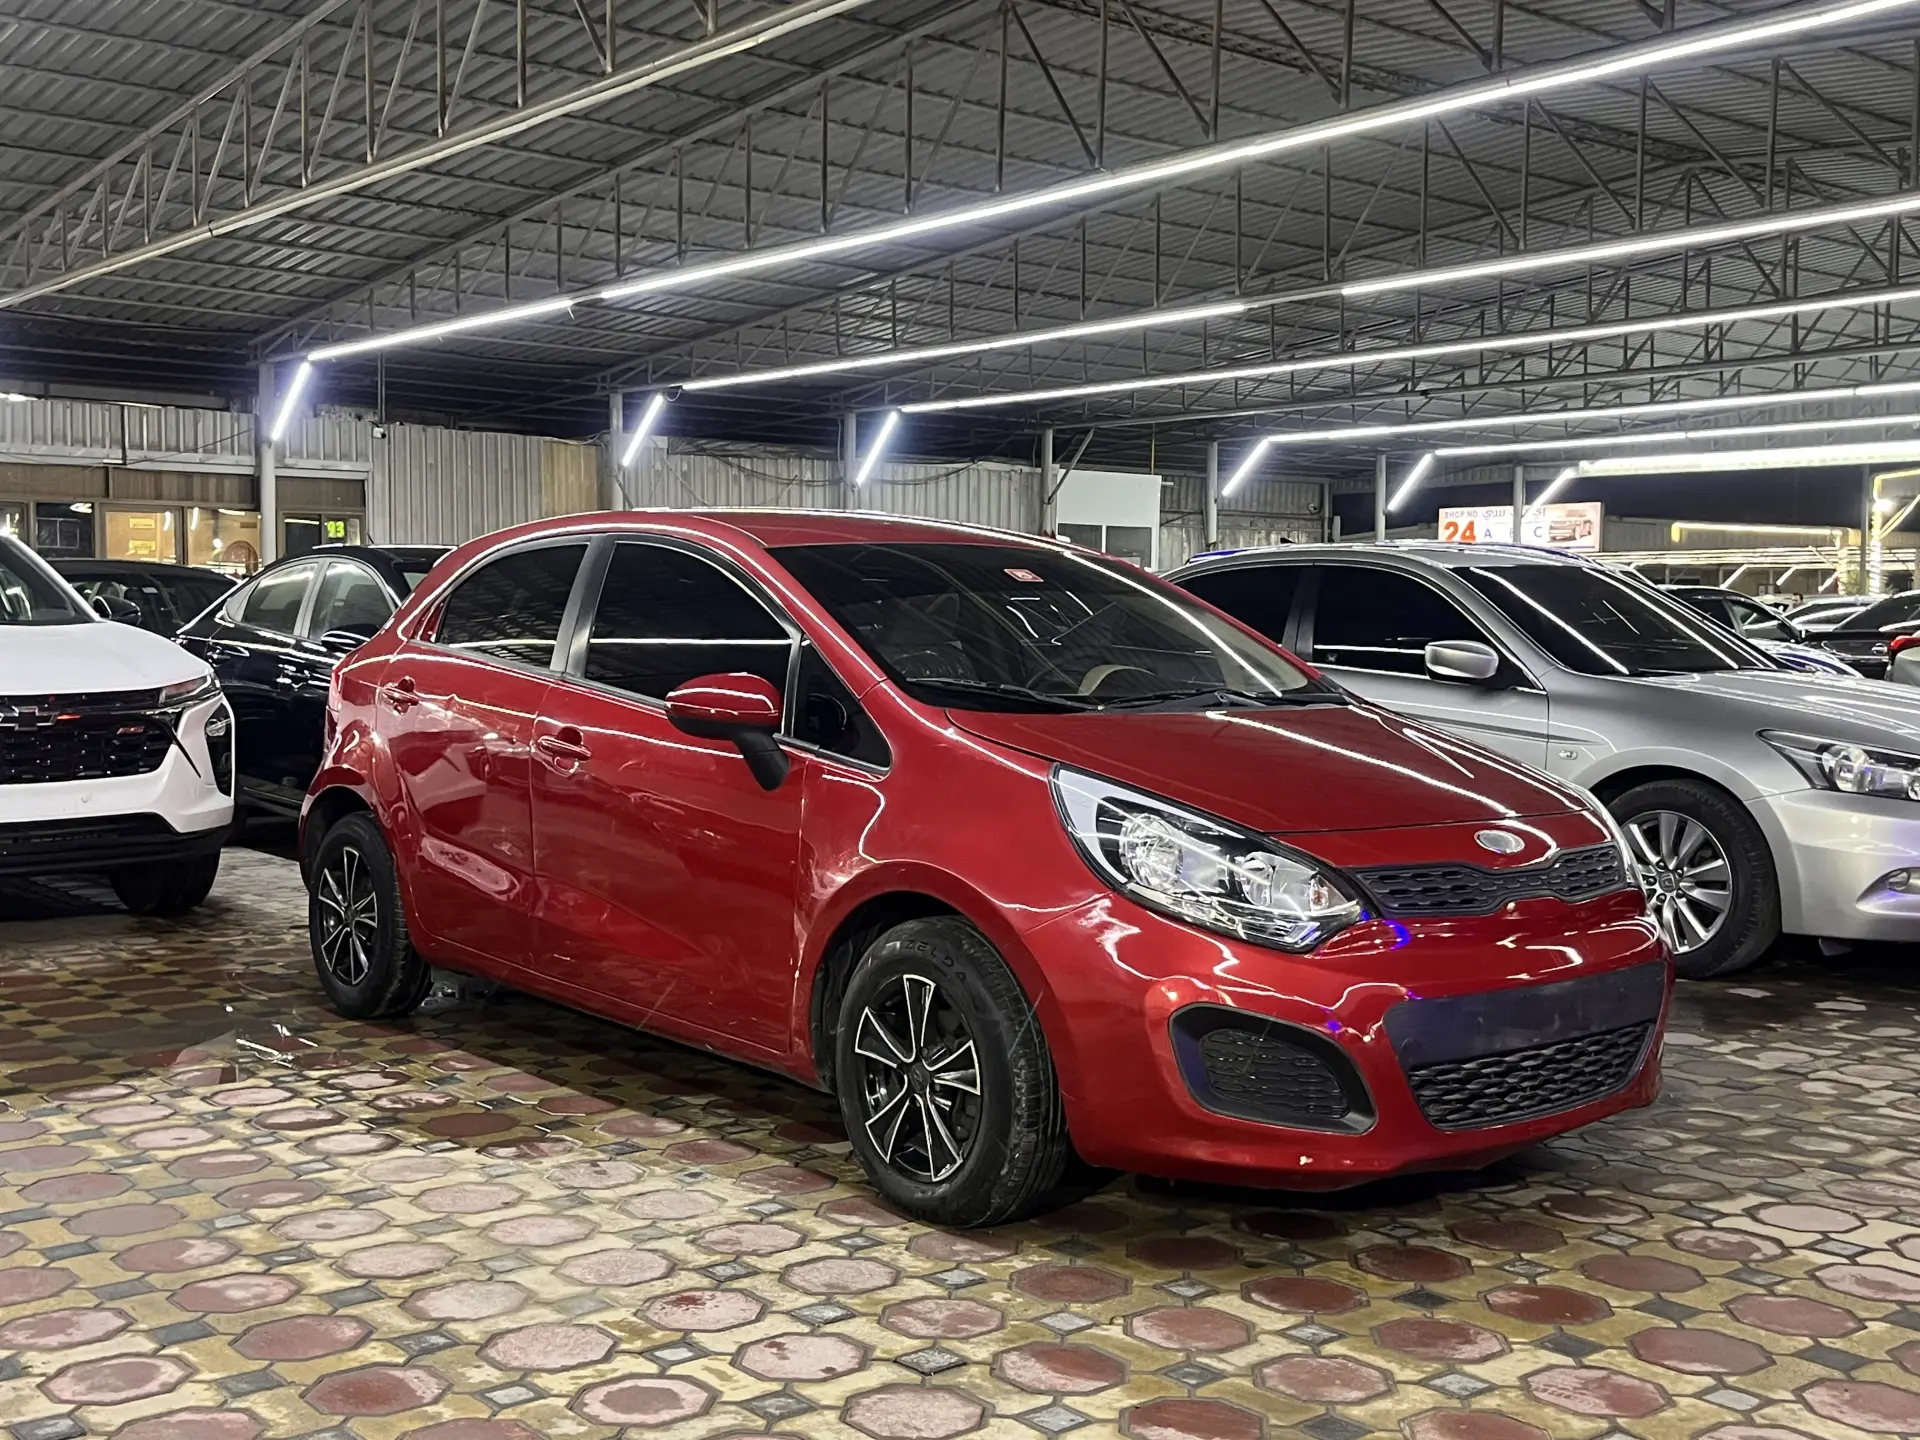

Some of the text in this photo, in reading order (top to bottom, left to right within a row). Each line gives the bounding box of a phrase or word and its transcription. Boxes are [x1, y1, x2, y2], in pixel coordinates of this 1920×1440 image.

[1444, 510, 1478, 519] SHOP NO
[1443, 520, 1477, 544] 24
[1483, 526, 1543, 539] A C
